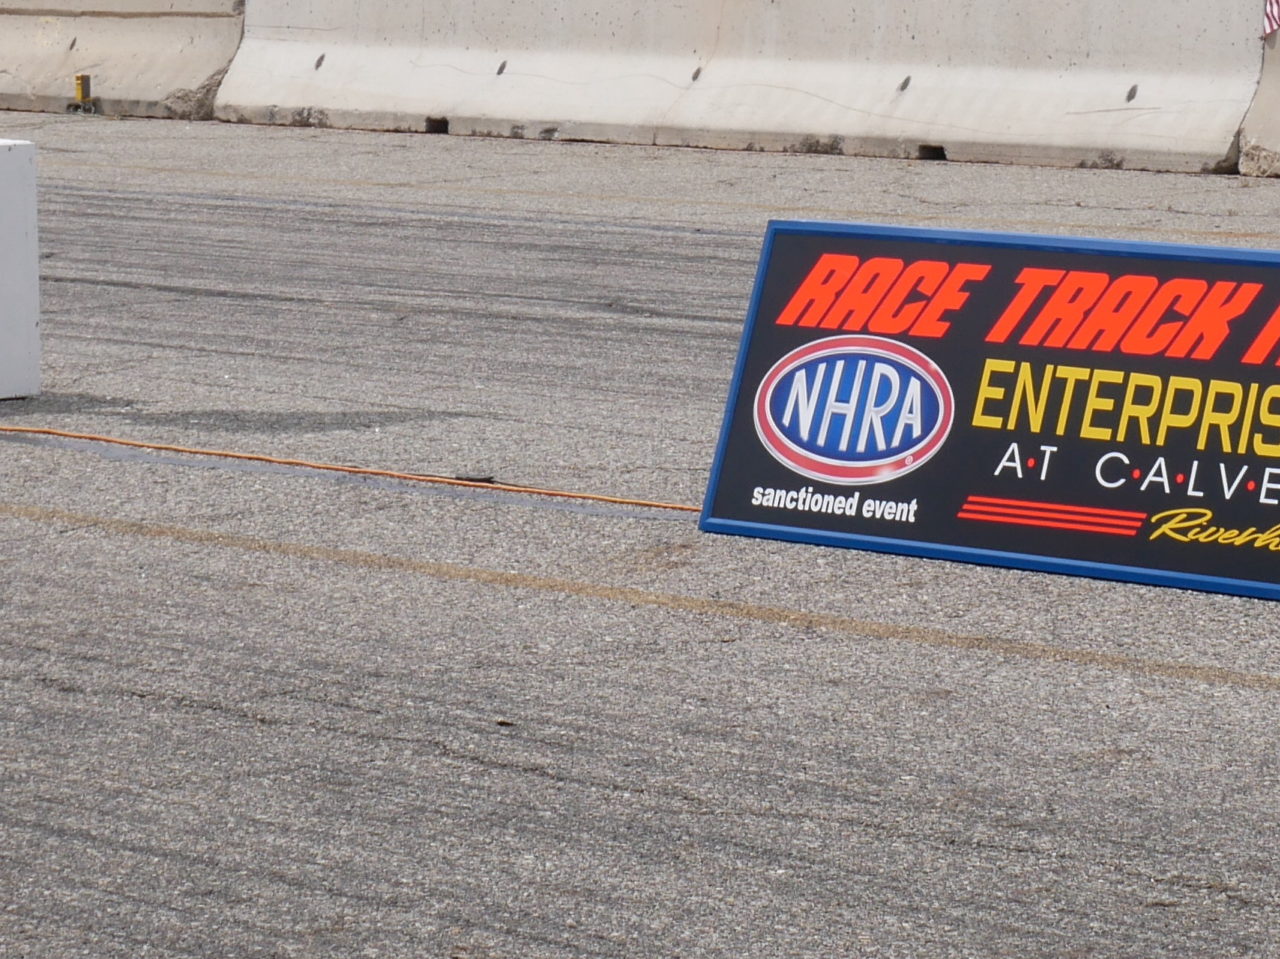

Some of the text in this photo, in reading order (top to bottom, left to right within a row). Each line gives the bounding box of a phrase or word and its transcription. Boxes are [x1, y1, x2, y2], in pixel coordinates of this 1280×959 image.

[775, 252, 992, 338] RACE
[984, 267, 1262, 361] TRACK
[782, 359, 922, 453] NHRA
[752, 487, 918, 523] sanctioned event
